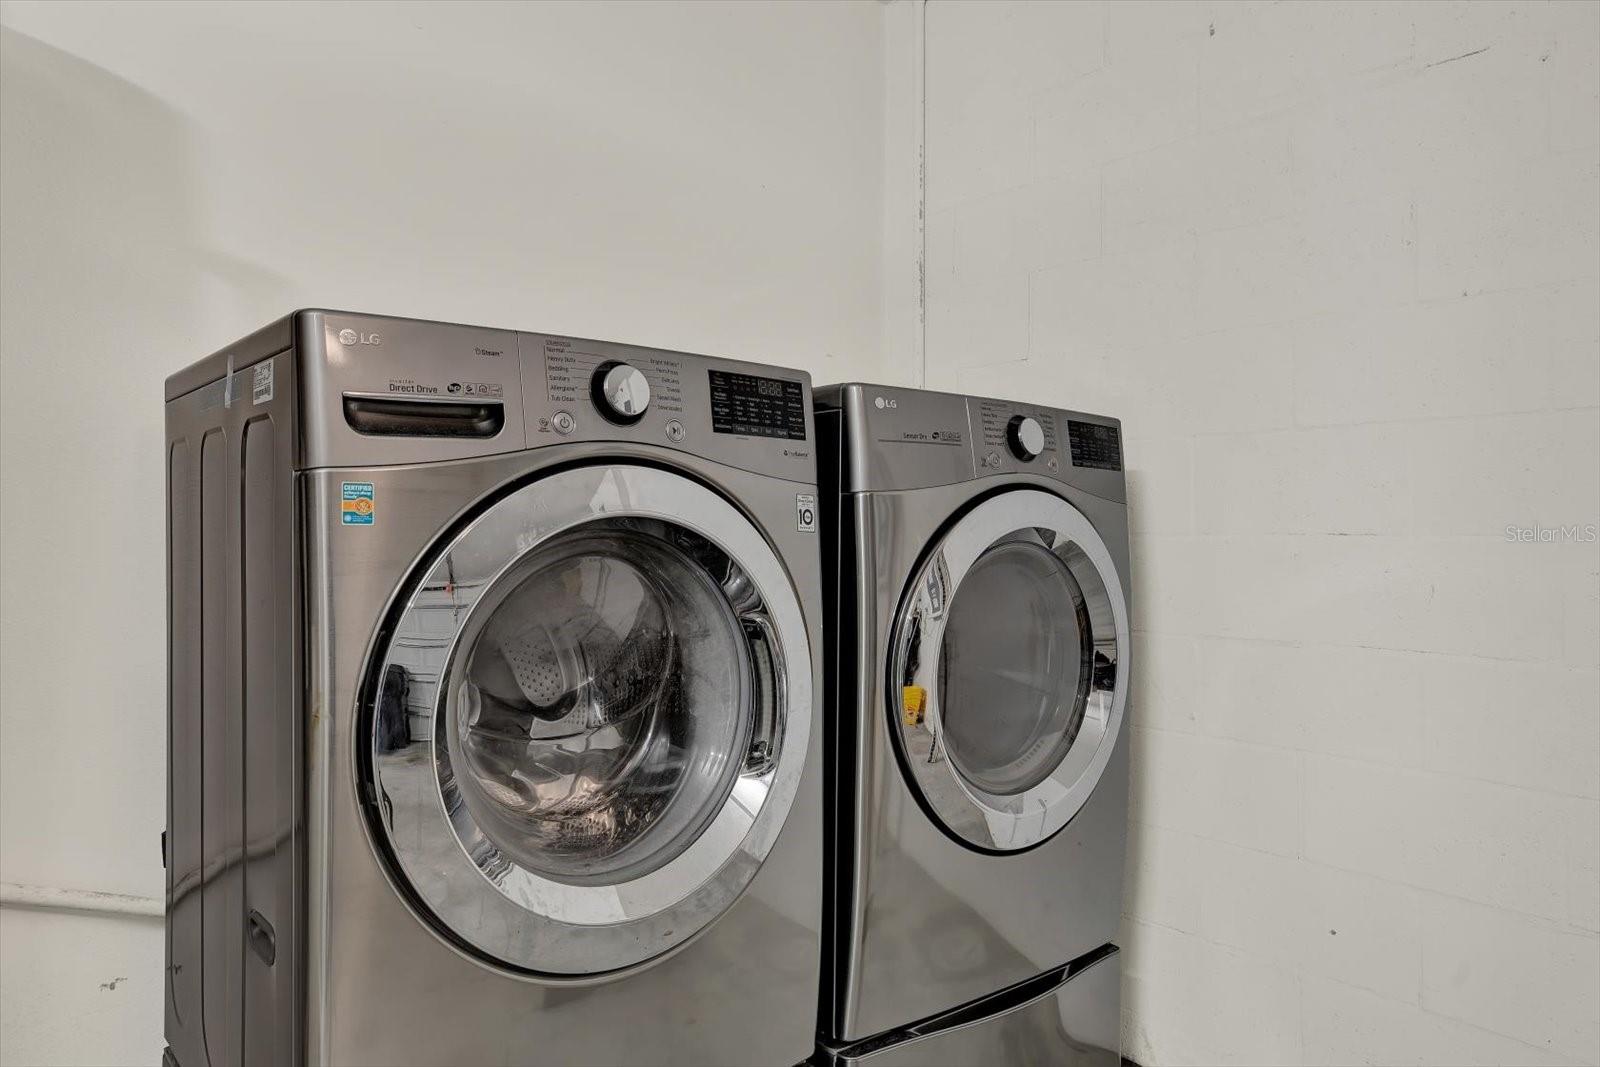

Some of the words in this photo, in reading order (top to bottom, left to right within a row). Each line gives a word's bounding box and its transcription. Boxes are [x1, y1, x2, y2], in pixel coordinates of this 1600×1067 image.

[360, 332, 381, 345] LG
[389, 383, 415, 393] Direct
[416, 385, 438, 394] Drive
[885, 399, 897, 409] LG
[799, 508, 813, 525] 10
